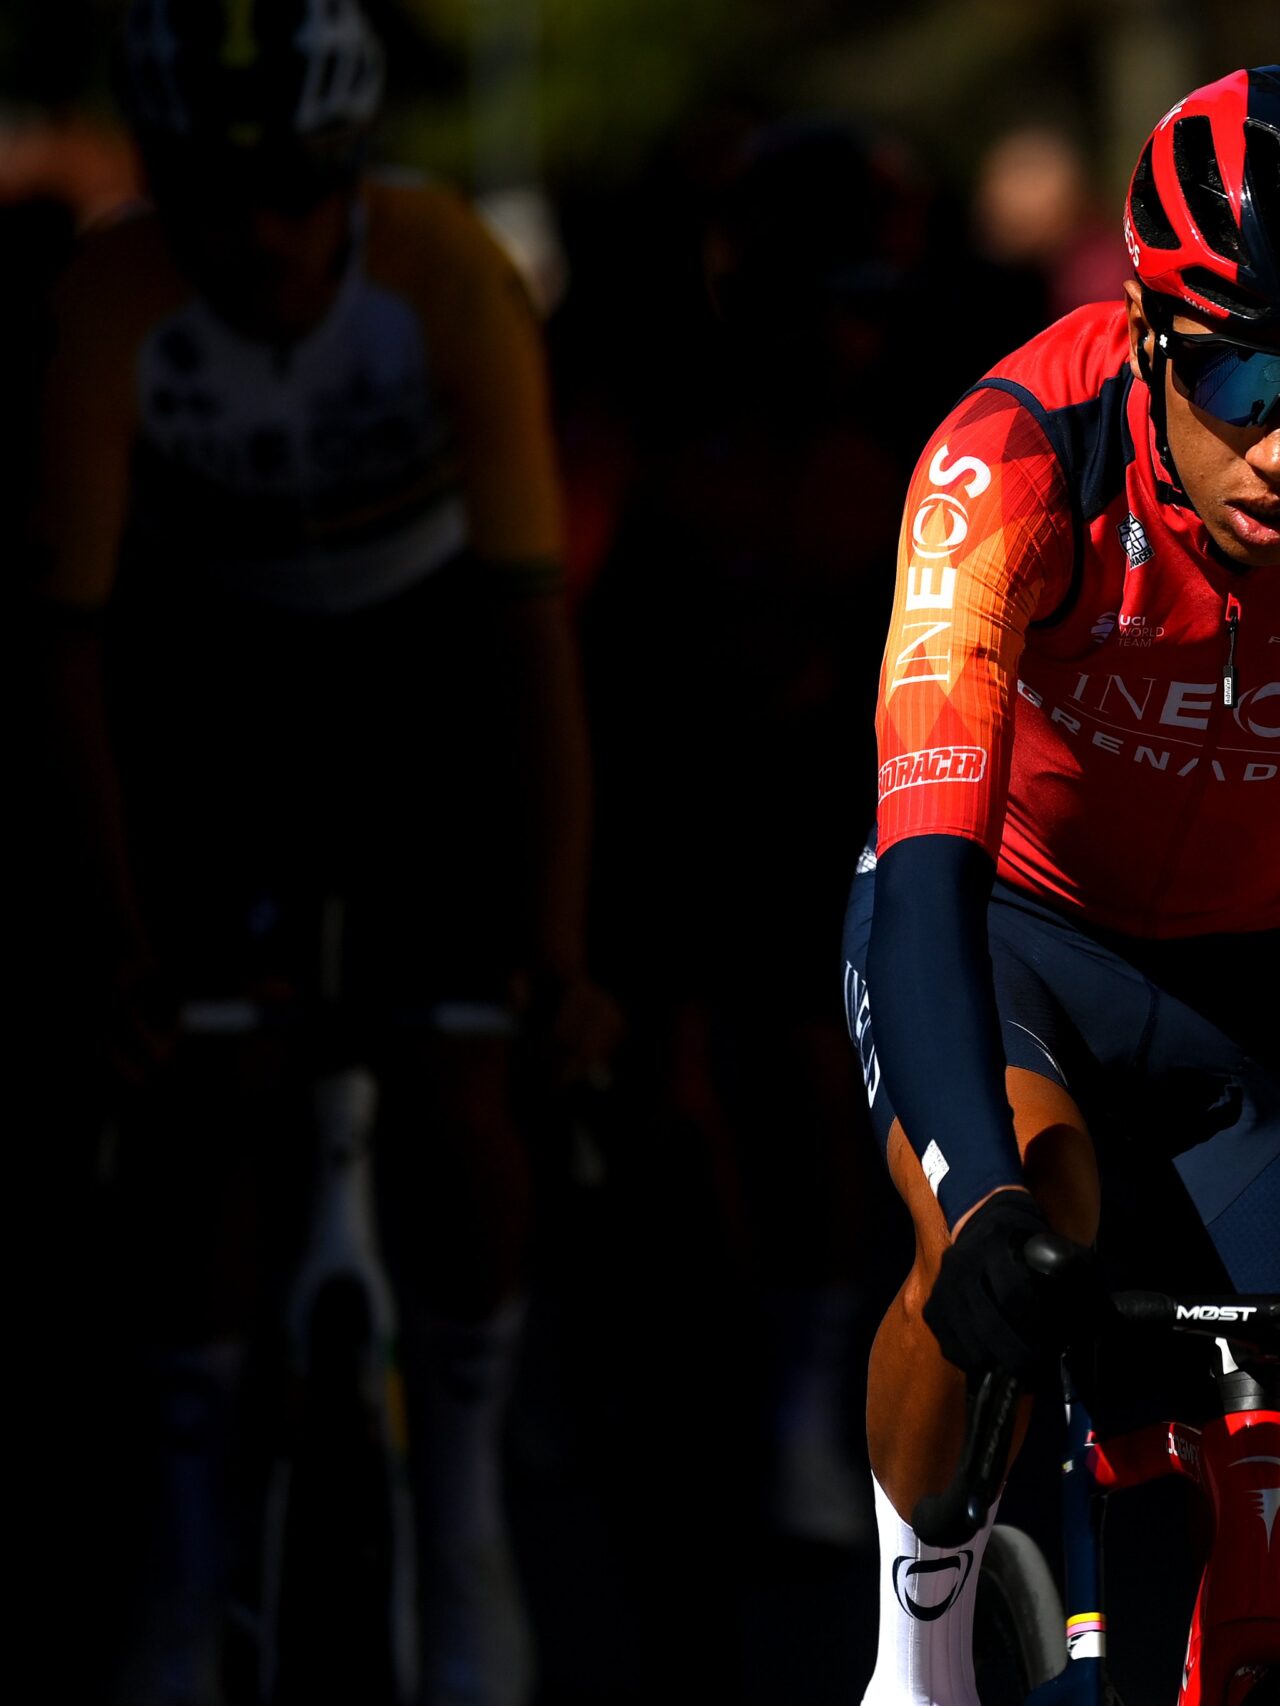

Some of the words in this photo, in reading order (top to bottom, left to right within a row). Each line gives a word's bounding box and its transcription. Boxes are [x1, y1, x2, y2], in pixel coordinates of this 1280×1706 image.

[889, 443, 991, 694] INEOS
[1120, 615, 1146, 626] UCI
[1119, 626, 1165, 638] WORLD
[1118, 638, 1152, 648] TEAM
